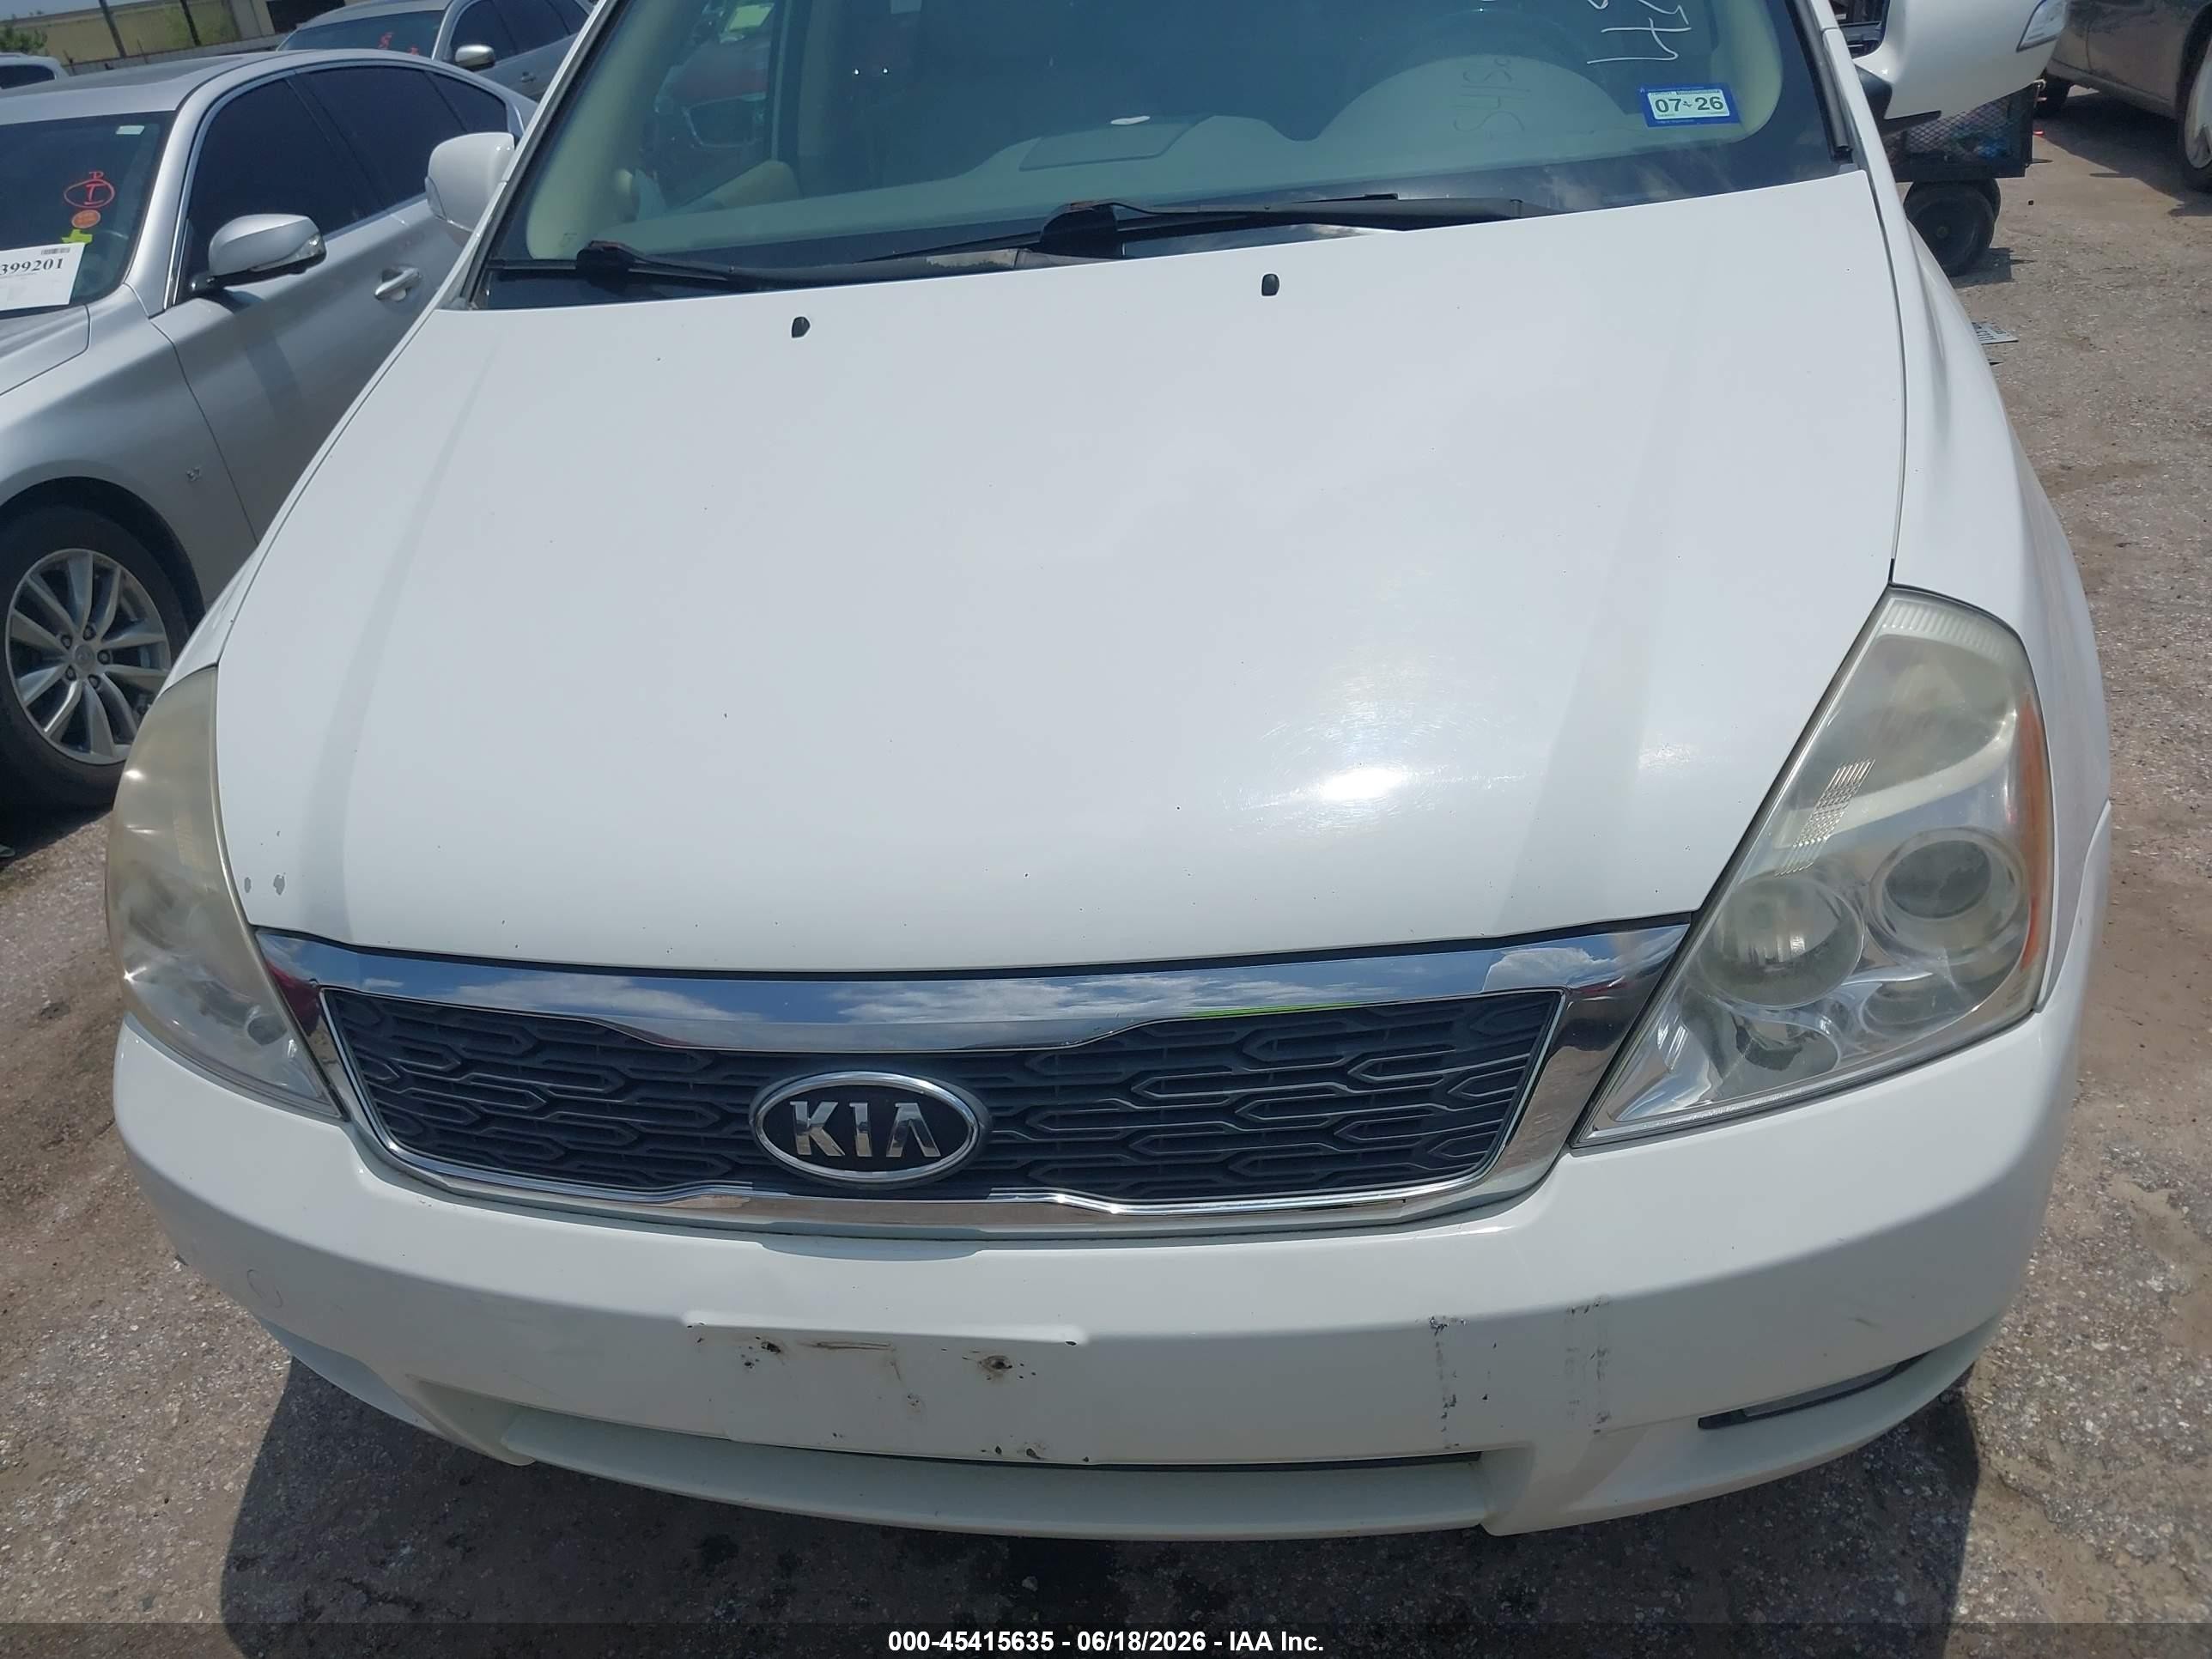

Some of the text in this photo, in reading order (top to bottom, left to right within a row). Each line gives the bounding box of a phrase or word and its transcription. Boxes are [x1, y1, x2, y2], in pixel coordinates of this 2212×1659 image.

[1655, 96, 1724, 113] 07 26
[789, 1101, 941, 1158] KIA
